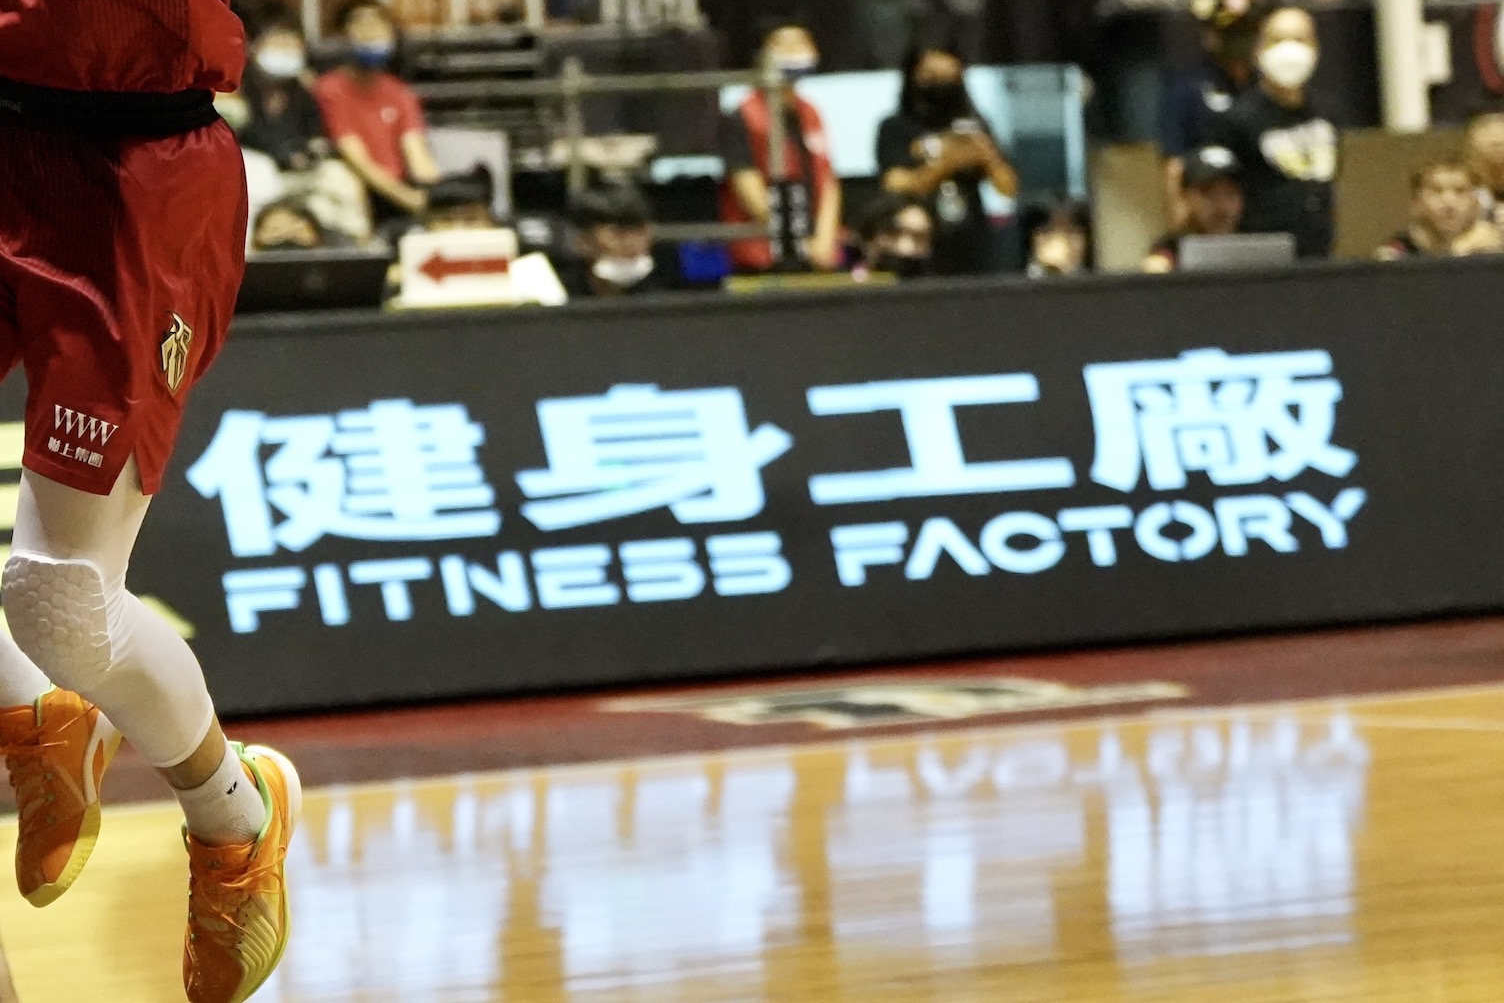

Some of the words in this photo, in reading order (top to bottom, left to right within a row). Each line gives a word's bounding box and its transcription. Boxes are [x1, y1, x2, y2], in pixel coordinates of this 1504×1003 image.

[186, 347, 1357, 557] 健身工廠
[221, 530, 793, 634] FITNESS
[829, 487, 1368, 587] FACTORY
